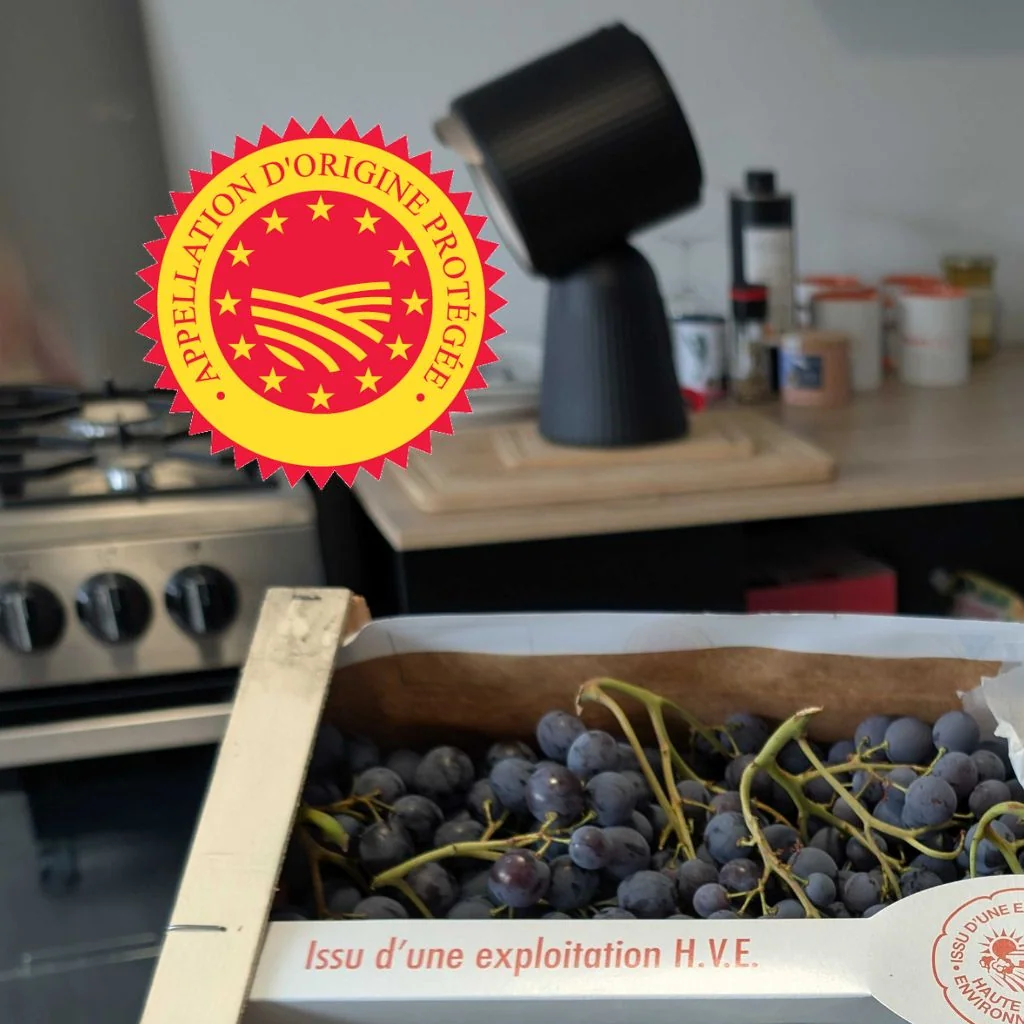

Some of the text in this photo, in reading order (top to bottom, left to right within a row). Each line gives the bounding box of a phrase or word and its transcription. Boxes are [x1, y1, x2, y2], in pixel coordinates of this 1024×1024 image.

[950, 931, 970, 963] ISSU
[964, 904, 1010, 934] D'UNE
[305, 936, 759, 977] Issu d'une exploitation H.V.E.
[971, 977, 1021, 1013] HAUTE
